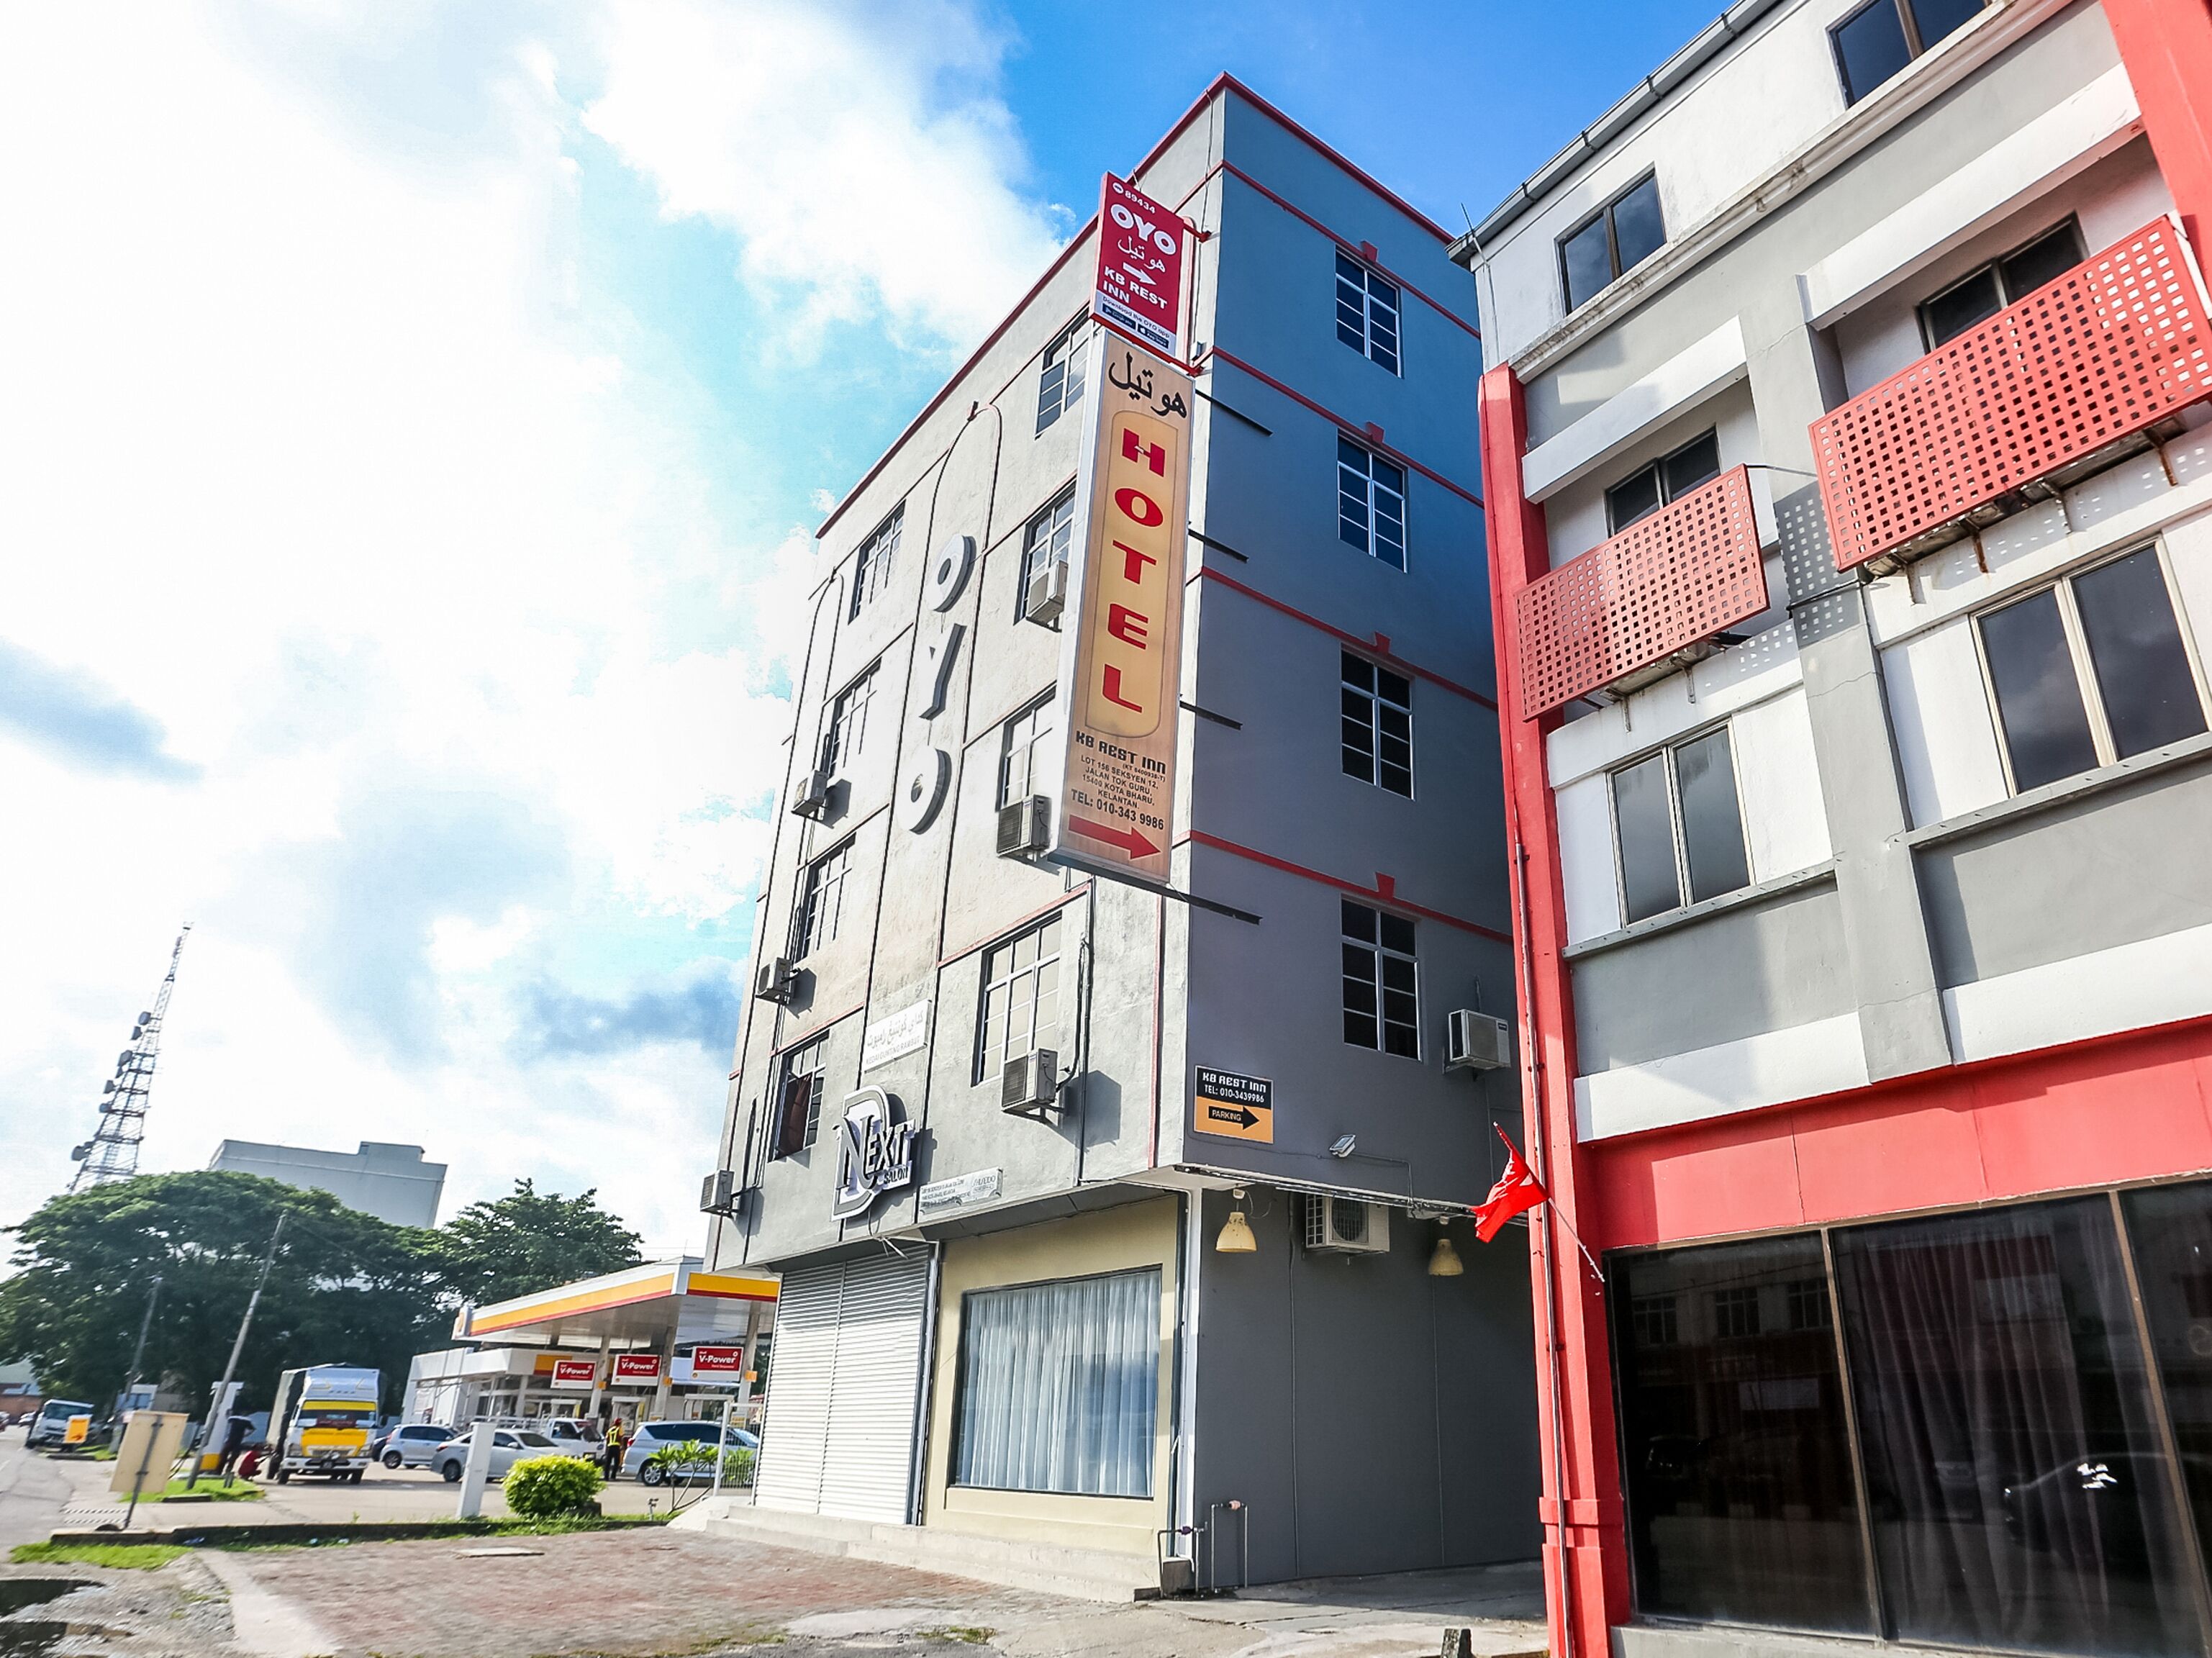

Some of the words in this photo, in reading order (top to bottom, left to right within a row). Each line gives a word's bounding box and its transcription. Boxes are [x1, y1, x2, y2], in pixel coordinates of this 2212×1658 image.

[1125, 190, 1156, 214] 89434
[1110, 204, 1177, 255] OYO
[1103, 281, 1130, 303] INN
[1105, 266, 1125, 286] KB
[1130, 282, 1167, 309] REST
[1103, 296, 1132, 316] Download
[1133, 312, 1142, 322] the
[1144, 320, 1157, 330] OYO
[1158, 329, 1170, 338] app
[1102, 427, 1166, 713] HOTEL
[896, 534, 976, 834] OYO
[1076, 730, 1094, 748] KB
[1098, 740, 1139, 764] REST
[1081, 755, 1095, 766] LOT
[1097, 762, 1110, 771] 156
[1111, 766, 1146, 784] SEKSYEN
[1085, 766, 1110, 780] JALAN
[1112, 776, 1127, 787] TOK
[1082, 774, 1102, 787] 15400
[1105, 782, 1125, 795] KOTA
[1071, 789, 1093, 807] TEL:
[1097, 798, 1137, 822] 010-343
[1140, 813, 1164, 830] 9986
[1202, 1072, 1216, 1083] KB
[1219, 1075, 1247, 1089] REST
[1205, 1084, 1218, 1095] TEL:
[1220, 1087, 1265, 1102] 010-3439986
[1212, 1110, 1241, 1121] PARKING
[884, 1167, 909, 1185] SALON
[622, 1362, 655, 1370] V-Power
[699, 1354, 736, 1364] V-Power
